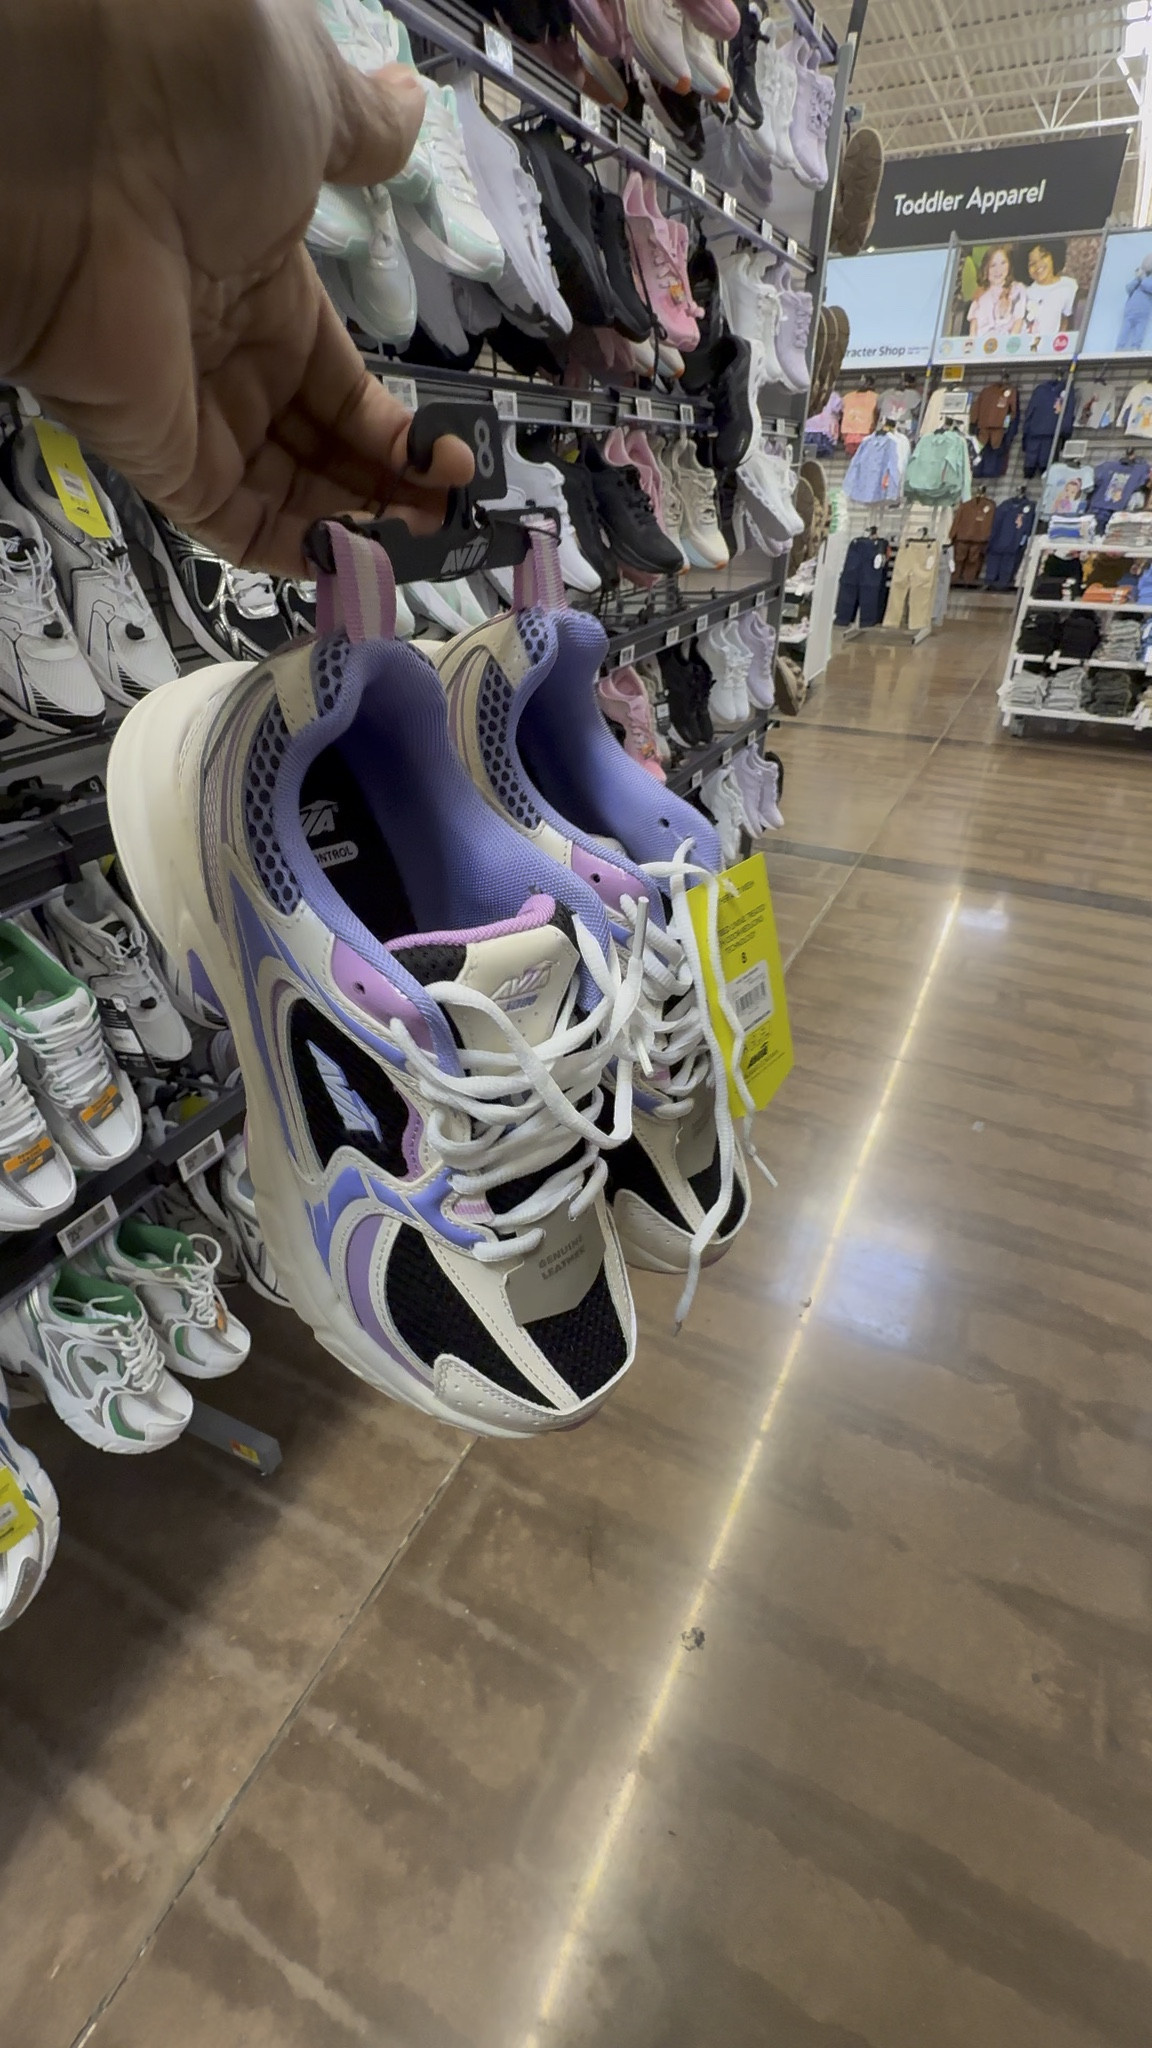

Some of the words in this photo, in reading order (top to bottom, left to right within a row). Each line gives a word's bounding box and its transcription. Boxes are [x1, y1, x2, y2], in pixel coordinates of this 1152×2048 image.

[894, 190, 964, 216] Toddler
[966, 179, 1046, 214] Apparel
[880, 346, 906, 358] Shop
[474, 417, 494, 478] 8
